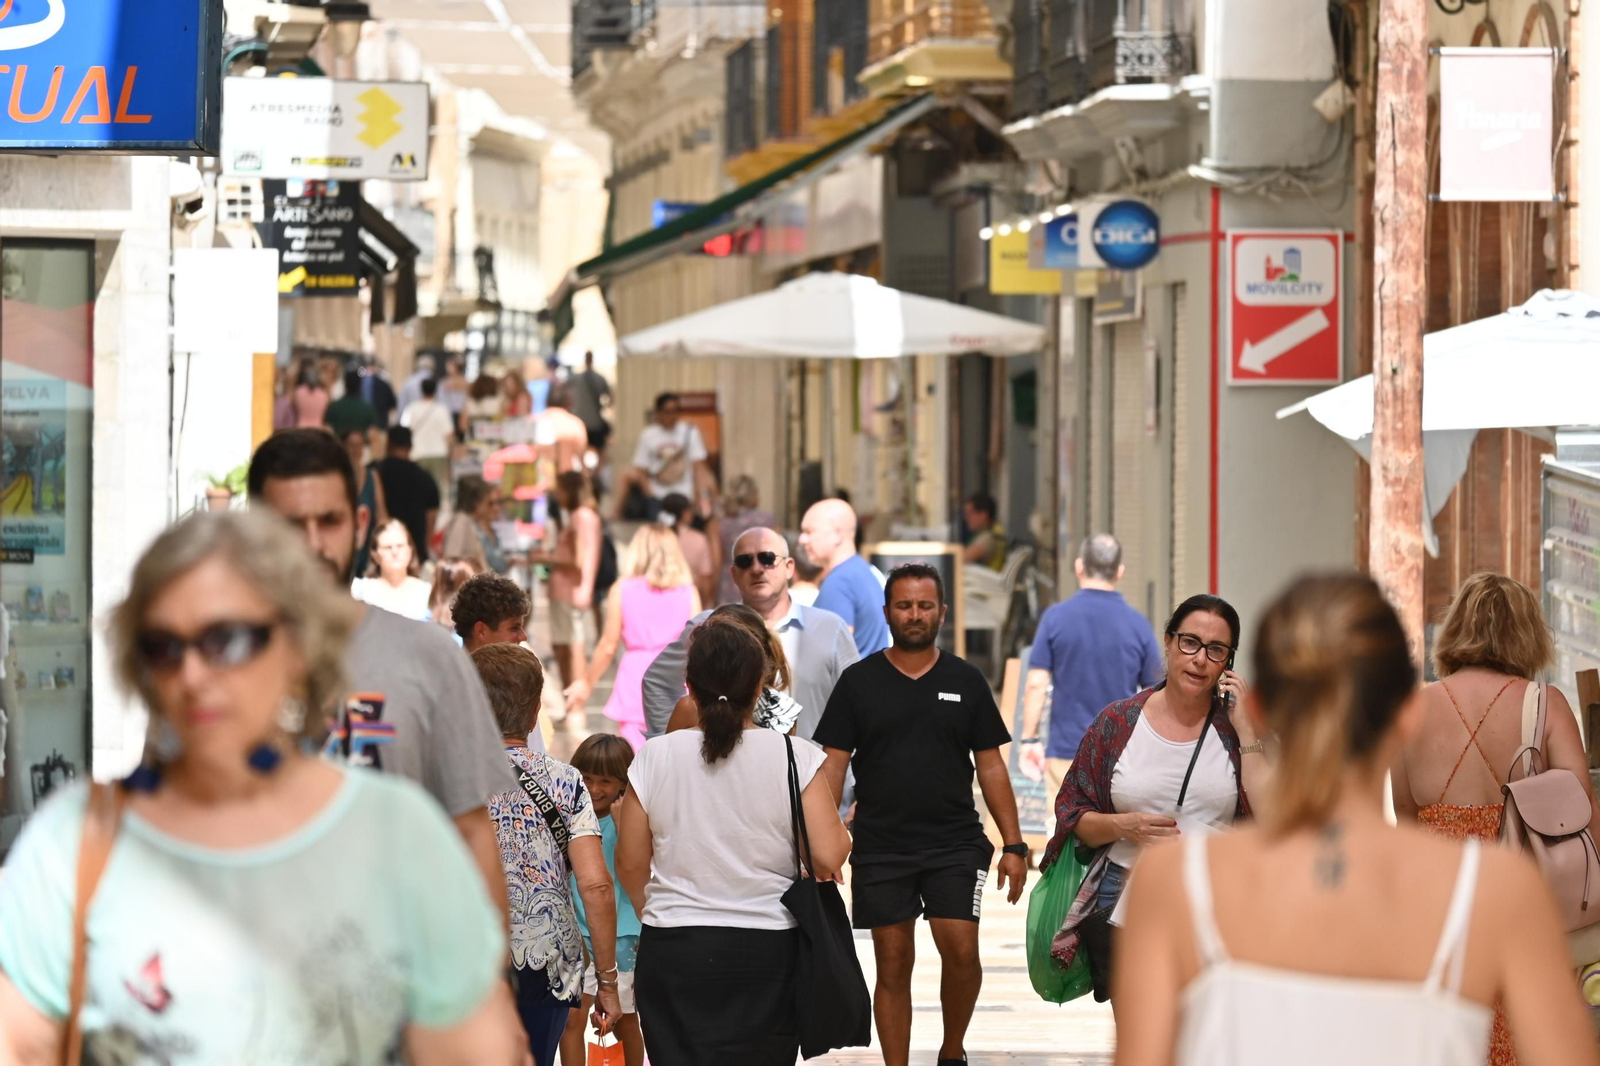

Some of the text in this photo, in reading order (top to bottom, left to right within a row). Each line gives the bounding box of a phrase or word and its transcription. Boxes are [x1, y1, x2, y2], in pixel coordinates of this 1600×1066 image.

[0, 65, 153, 124] UAL
[1094, 228, 1156, 244] DIGI
[1245, 282, 1324, 296] MOVILCITY
[938, 692, 961, 702] PUMA
[518, 771, 554, 813] BIMBA
